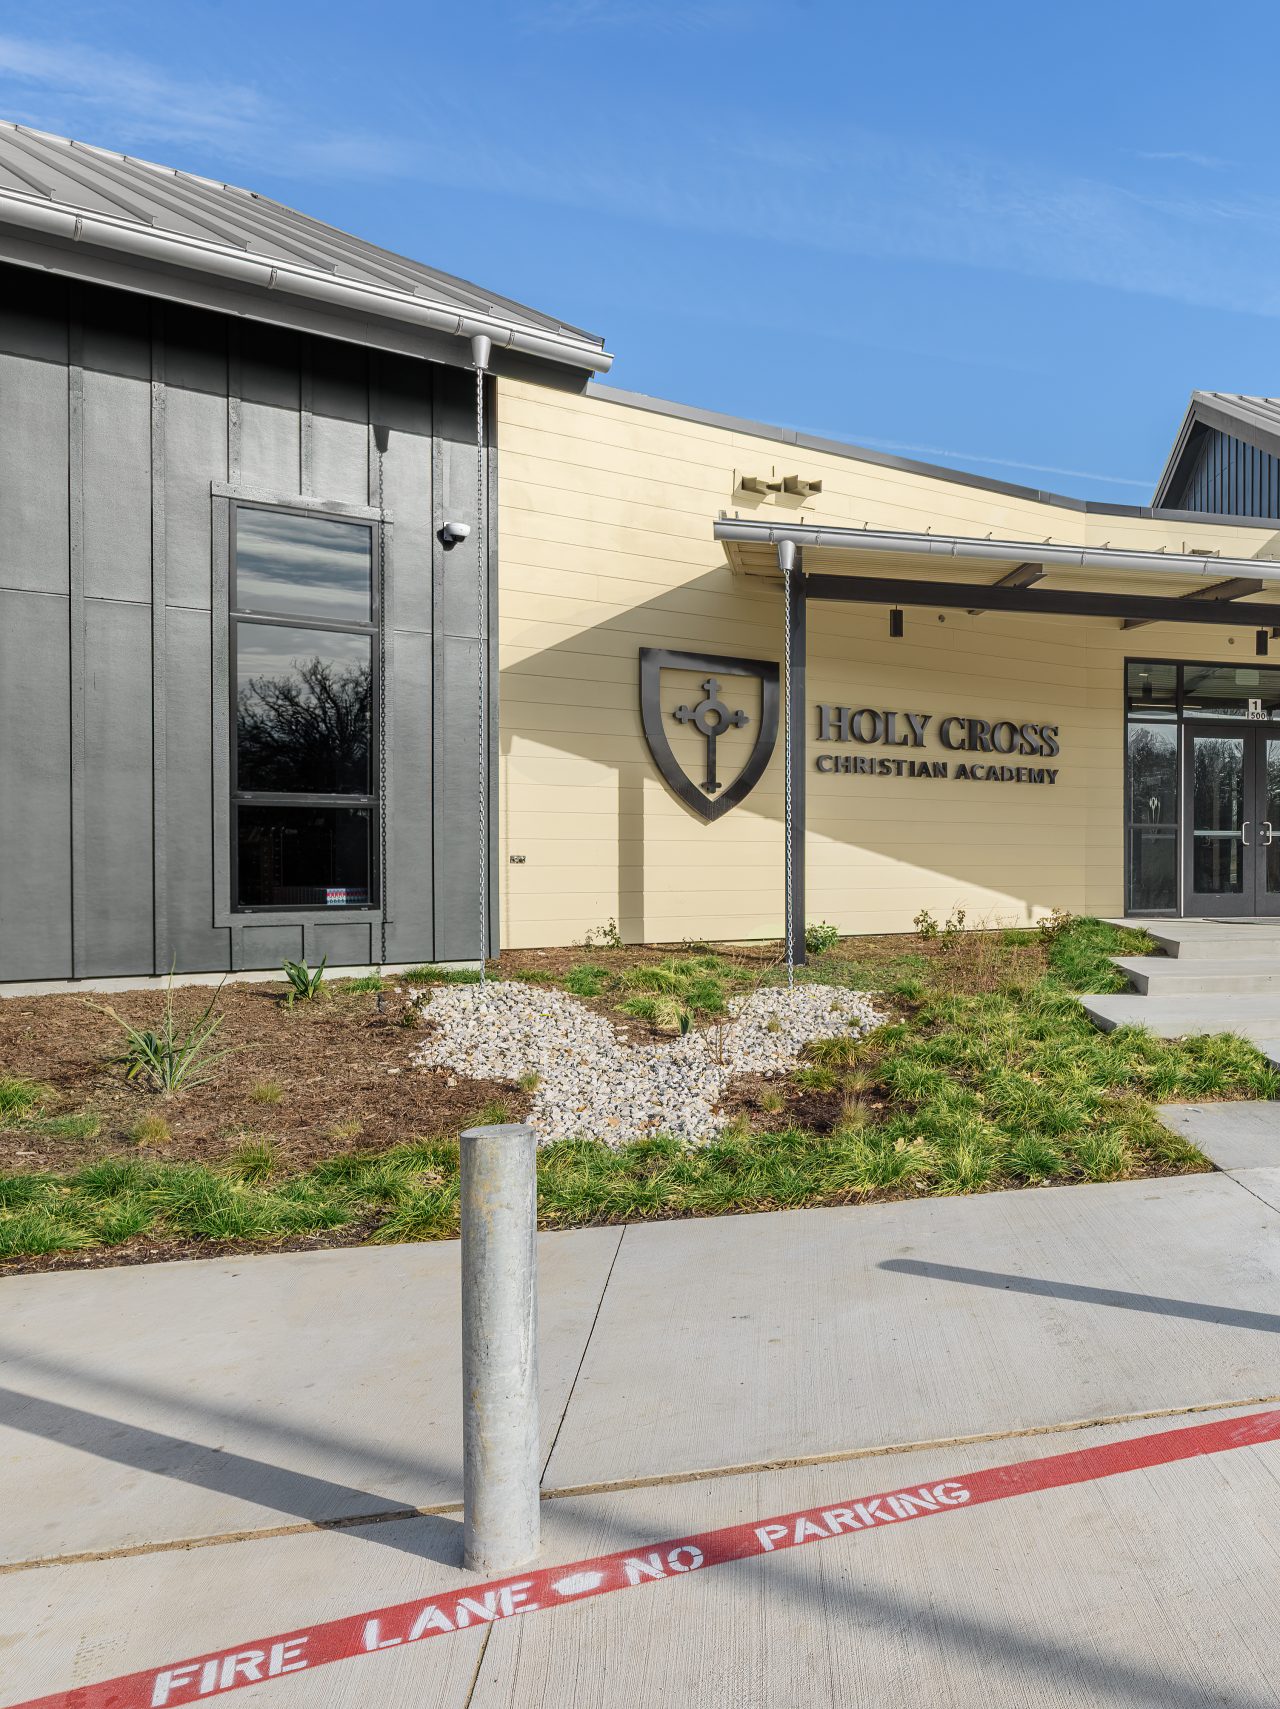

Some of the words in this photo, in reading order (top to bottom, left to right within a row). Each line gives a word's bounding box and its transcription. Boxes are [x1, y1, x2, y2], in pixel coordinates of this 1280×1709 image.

[1252, 701, 1258, 710] 1
[816, 704, 932, 747] HOLY
[939, 716, 1060, 757] CROSS
[816, 754, 948, 779] CHRISTIAN
[954, 763, 1059, 785] ACADEMY
[151, 1636, 308, 1708] FIRE
[362, 1581, 538, 1651] LANE
[624, 1545, 704, 1586] NO
[754, 1482, 971, 1552] PARKING
